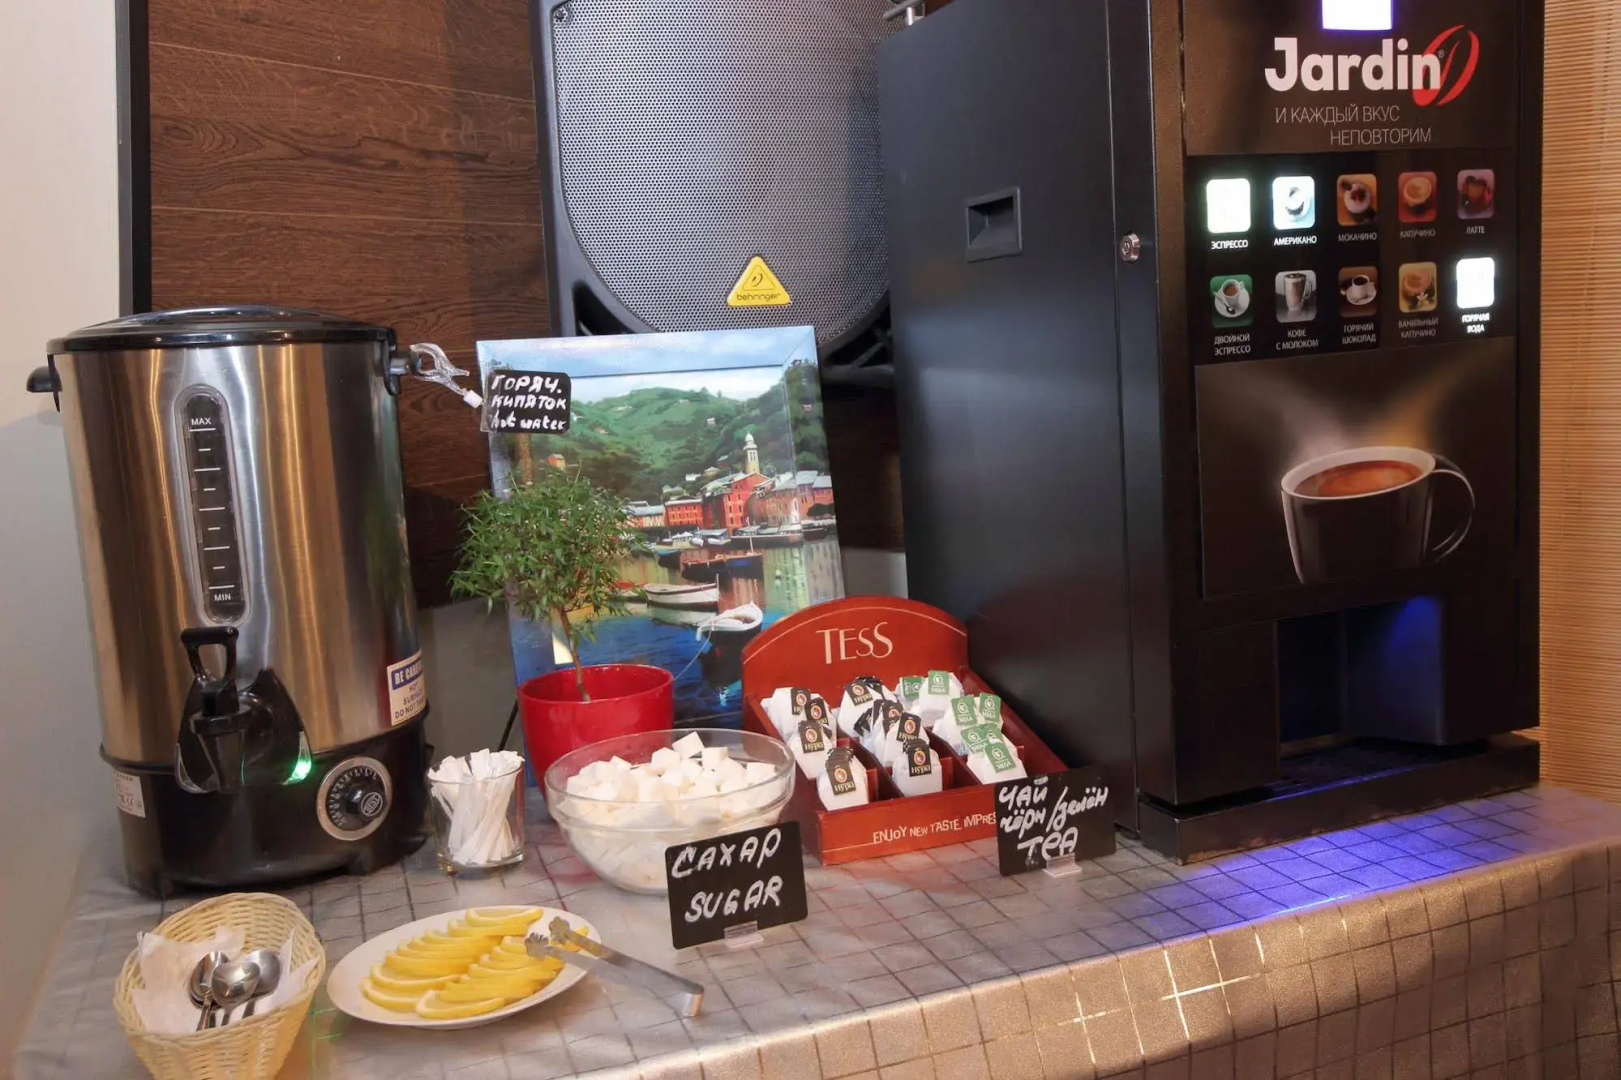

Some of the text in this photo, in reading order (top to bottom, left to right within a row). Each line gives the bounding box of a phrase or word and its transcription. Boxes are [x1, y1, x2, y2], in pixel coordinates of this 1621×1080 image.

[1265, 37, 1441, 92] Jardin
[1275, 104, 1400, 125] И КАЖДЫЙ ВКУС
[1330, 128, 1431, 145] НЕПОВТОРИМ
[1400, 229, 1436, 239] КАПУЧИНО
[1465, 226, 1485, 235] ЛАТТЕ
[1273, 235, 1317, 246] АМЕРИКАНО
[1338, 232, 1377, 242] МОКАЧИНО
[1211, 239, 1249, 250] ЭСПРЕССО
[736, 292, 781, 302] behringer
[1343, 322, 1374, 333] ГОРЯЧИЙ
[1466, 324, 1485, 334] ВОДА
[1288, 329, 1307, 338] КОФЕ
[1342, 334, 1376, 344] ШОКОЛАД
[1401, 329, 1436, 339] КАПУЧИНО
[1214, 333, 1250, 346] ДВОЙНОЙ
[1276, 339, 1319, 350] С МОЛОКОМ
[1214, 346, 1251, 356] ЭСПРЕССО
[191, 418, 212, 426] MAX
[214, 593, 231, 601] MIN
[815, 621, 893, 665] TESS
[394, 671, 404, 685] BE
[910, 826, 929, 837] NEW
[930, 819, 962, 833] TASTE
[671, 828, 782, 878] САХАР
[684, 875, 783, 923] SUGAR
